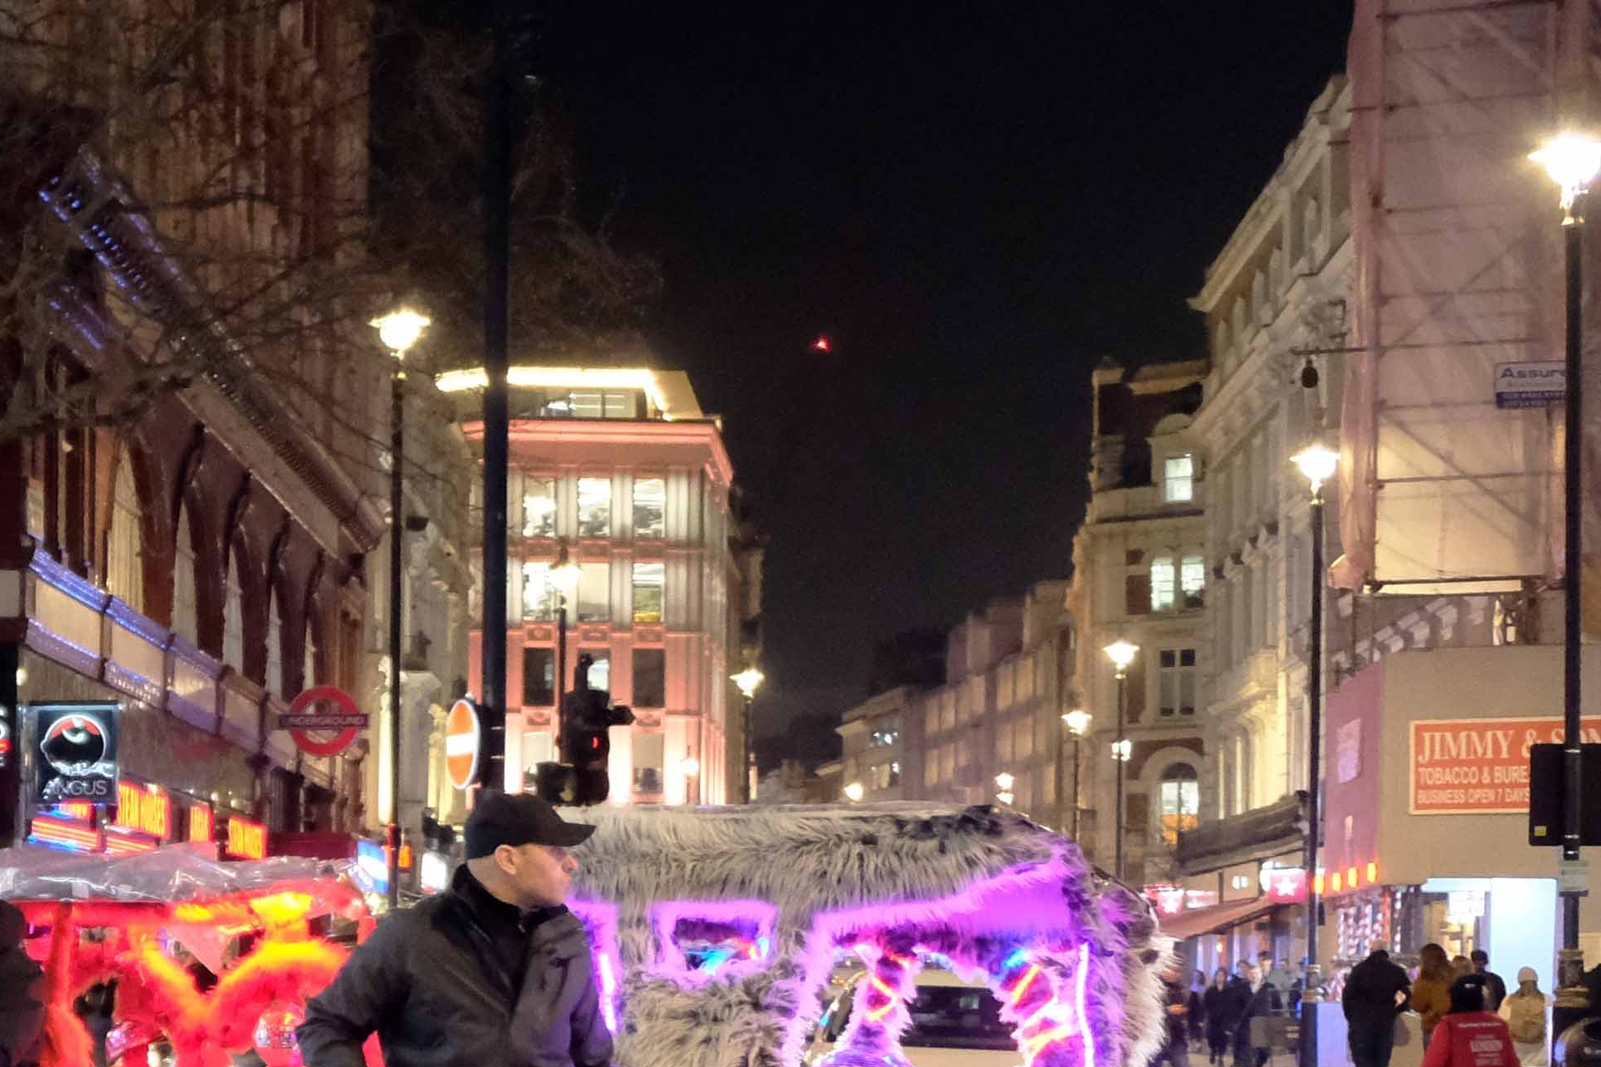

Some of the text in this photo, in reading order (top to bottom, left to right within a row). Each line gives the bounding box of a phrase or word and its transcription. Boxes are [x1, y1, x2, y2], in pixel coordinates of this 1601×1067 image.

[282, 715, 365, 727] UNDERGROUND
[1418, 730, 1514, 764] JIMMY
[1418, 765, 1529, 785] TOBACCO & BURE
[45, 779, 107, 796] ANGUS
[1417, 788, 1466, 804] BUSINESS
[1468, 787, 1496, 803] OPEN
